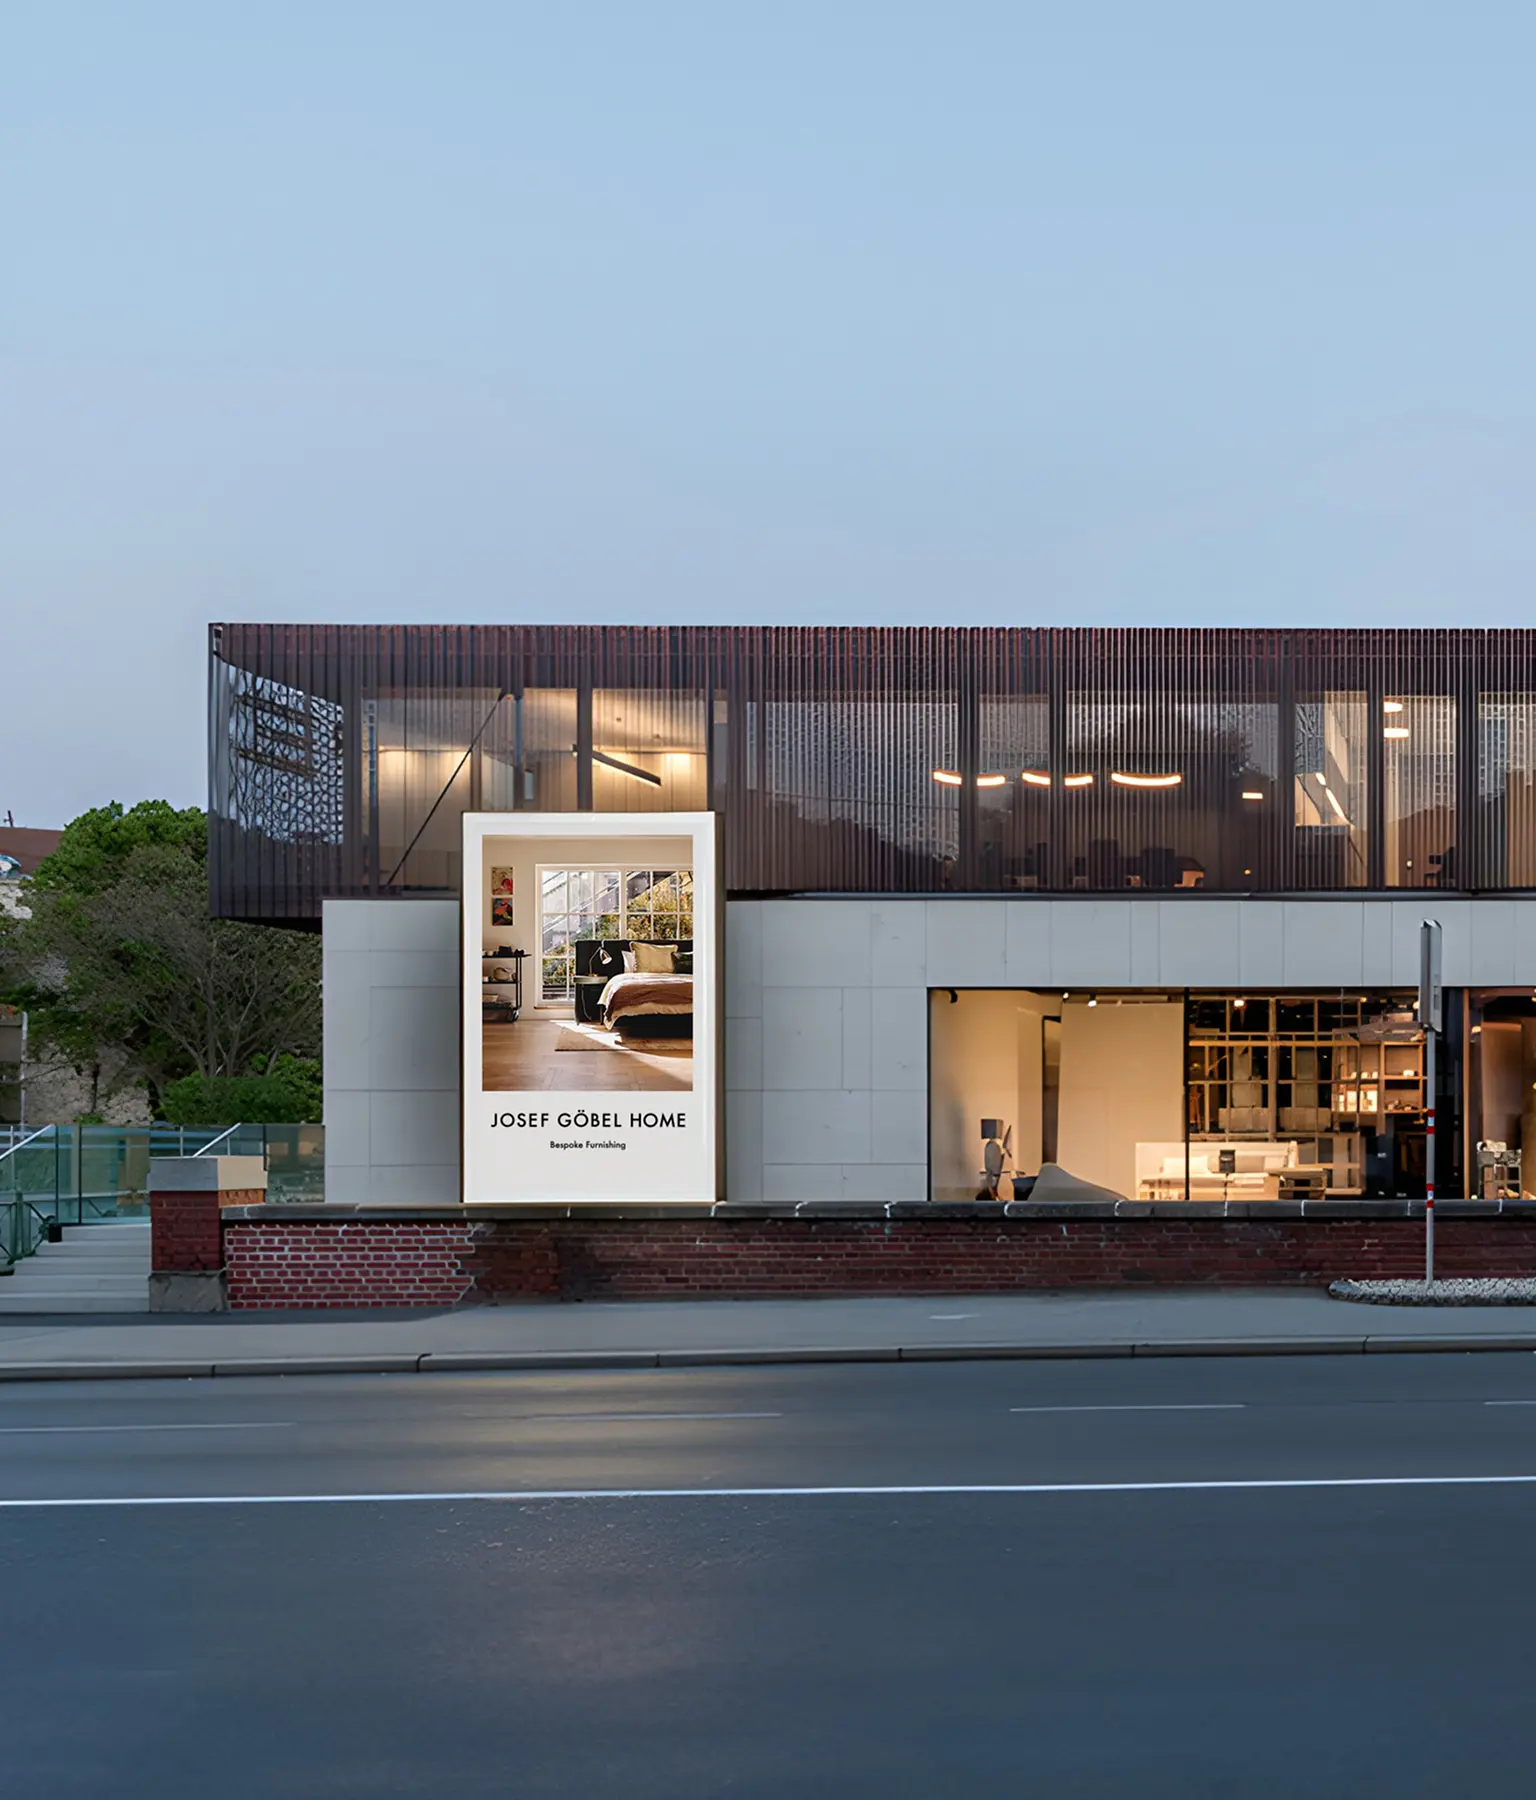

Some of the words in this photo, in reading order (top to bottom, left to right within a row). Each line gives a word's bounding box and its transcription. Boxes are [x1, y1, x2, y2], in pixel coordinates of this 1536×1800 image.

[490, 1112, 549, 1128] JOSEF
[557, 1109, 622, 1128] GÖBEL
[630, 1112, 686, 1128] HOME
[549, 1140, 584, 1151] Bespoke
[585, 1140, 627, 1151] Furnishing
